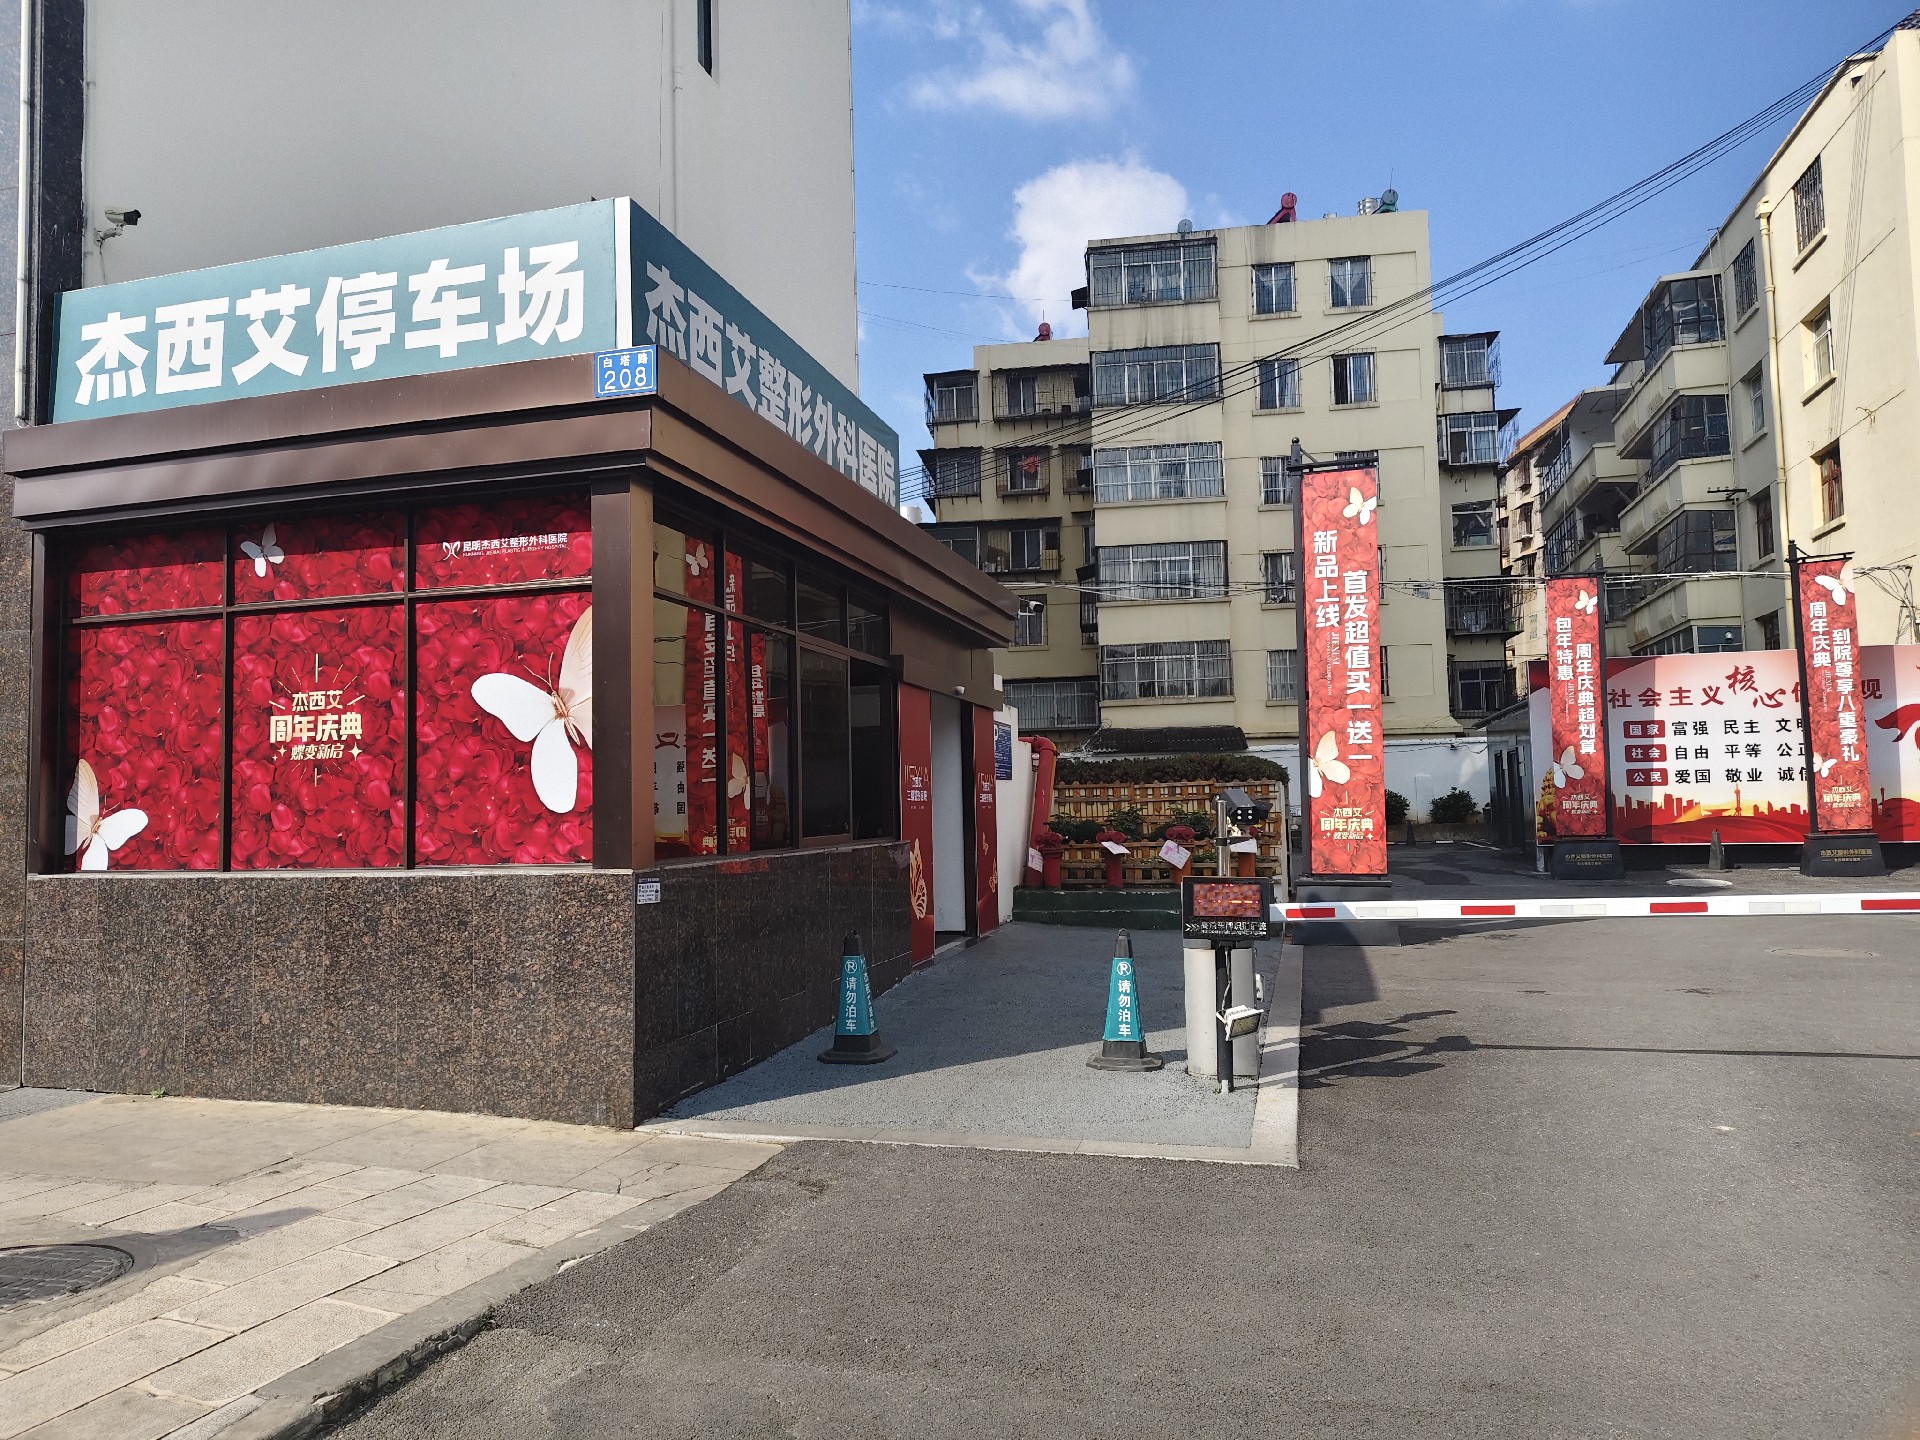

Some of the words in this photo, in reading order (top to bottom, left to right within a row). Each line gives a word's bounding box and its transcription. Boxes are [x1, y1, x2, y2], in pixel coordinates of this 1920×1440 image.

[75, 241, 586, 406] 杰西艾停车场
[603, 352, 648, 368] 白塔路
[604, 366, 647, 391] 208
[645, 261, 896, 508] 杰西艾整形外科医院
[463, 533, 568, 552] 昆明杰西艾整形外科医院
[1313, 530, 1340, 628] 新品上线
[1555, 617, 1574, 681] 包年特惠
[1809, 602, 1831, 668] 周年庆典
[1343, 570, 1373, 761] 首发超值买一送一
[291, 690, 343, 711] 杰西艾
[1576, 643, 1596, 755] 周年庆典超划算
[1832, 628, 1859, 762] 到院尊享八重豪礼
[269, 712, 362, 743] 周年庆典
[1629, 724, 1660, 736] 国家
[1671, 720, 1710, 736] 富强
[1724, 719, 1761, 735] 民主
[290, 743, 344, 760] 蝶变新启
[1631, 747, 1661, 759] 社会
[1675, 745, 1709, 761] 自由
[1725, 743, 1762, 758] 平等
[1633, 771, 1663, 783] 公民
[1675, 769, 1711, 784] 爱国
[1725, 768, 1763, 783] 敬业
[1562, 800, 1598, 809] 周年庆典
[1823, 793, 1861, 803] 周年庆典
[1320, 817, 1373, 831] 周年庆典
[845, 976, 857, 1033] 请勿泊车
[1117, 979, 1131, 1037] 请勿泊车
